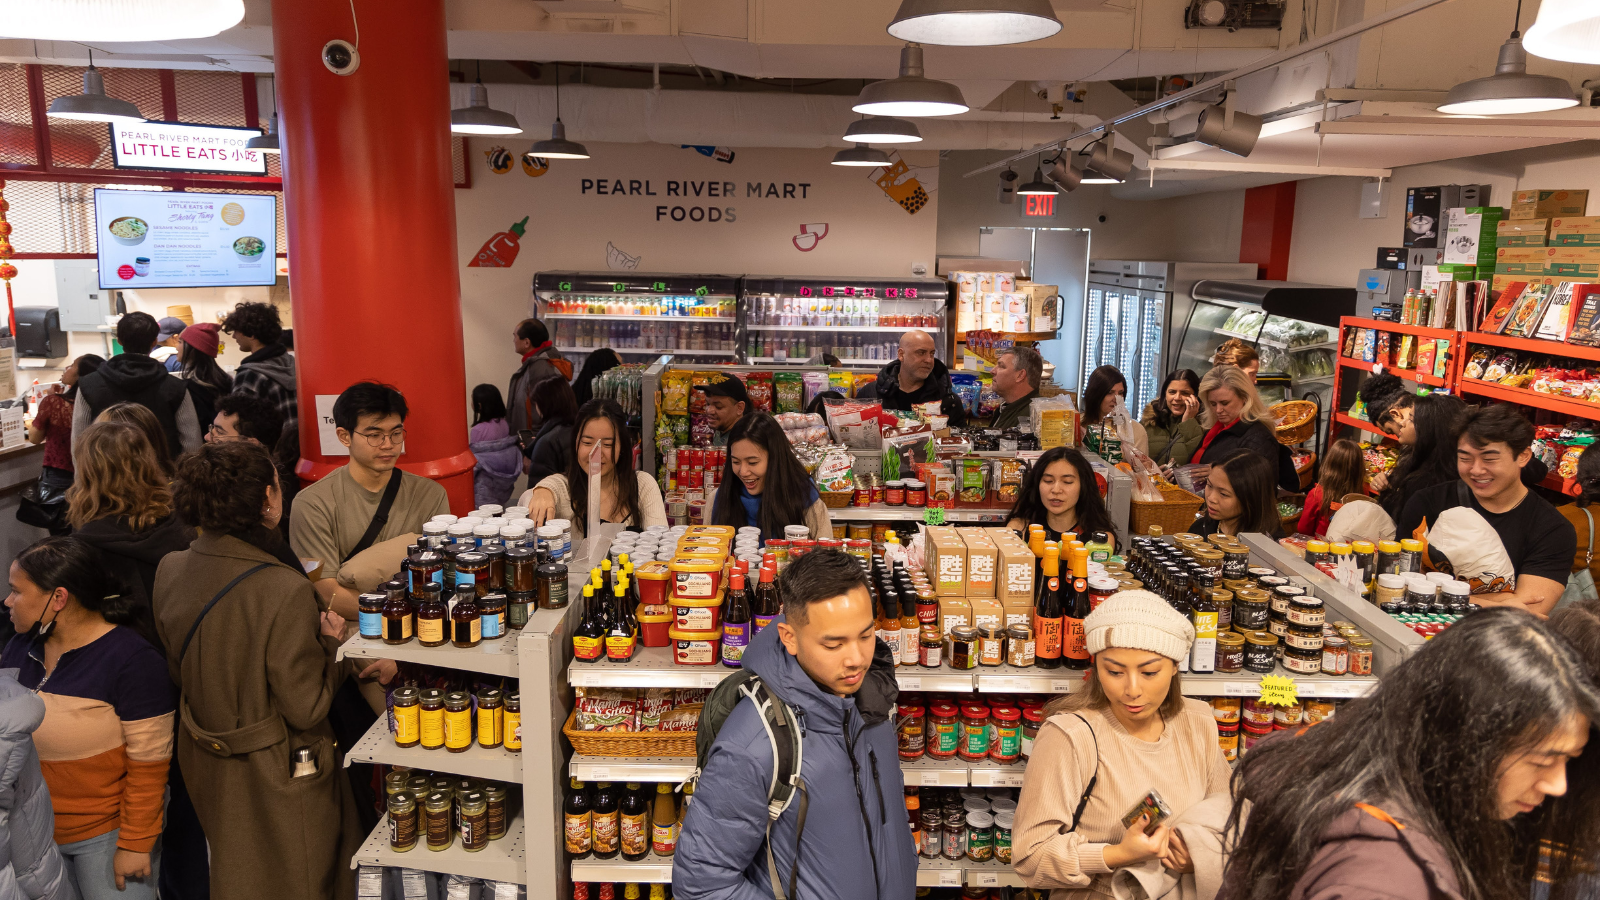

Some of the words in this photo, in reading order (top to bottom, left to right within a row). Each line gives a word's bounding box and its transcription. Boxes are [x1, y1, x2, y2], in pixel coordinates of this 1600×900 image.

[121, 131, 156, 141] PEARL
[159, 134, 190, 143] RIVER
[192, 136, 220, 144] MART
[122, 143, 181, 158] LITTLE
[187, 146, 227, 160] EATS
[581, 179, 657, 195] PEARL
[667, 181, 736, 197] RIVER
[746, 182, 811, 199] MART
[1026, 194, 1055, 216] EXIT
[656, 206, 737, 223] FOODS
[643, 698, 662, 707] ama
[674, 688, 704, 704] Mama
[588, 699, 620, 712] Mama
[602, 704, 633, 719] Sita's
[662, 718, 696, 731] Mama
